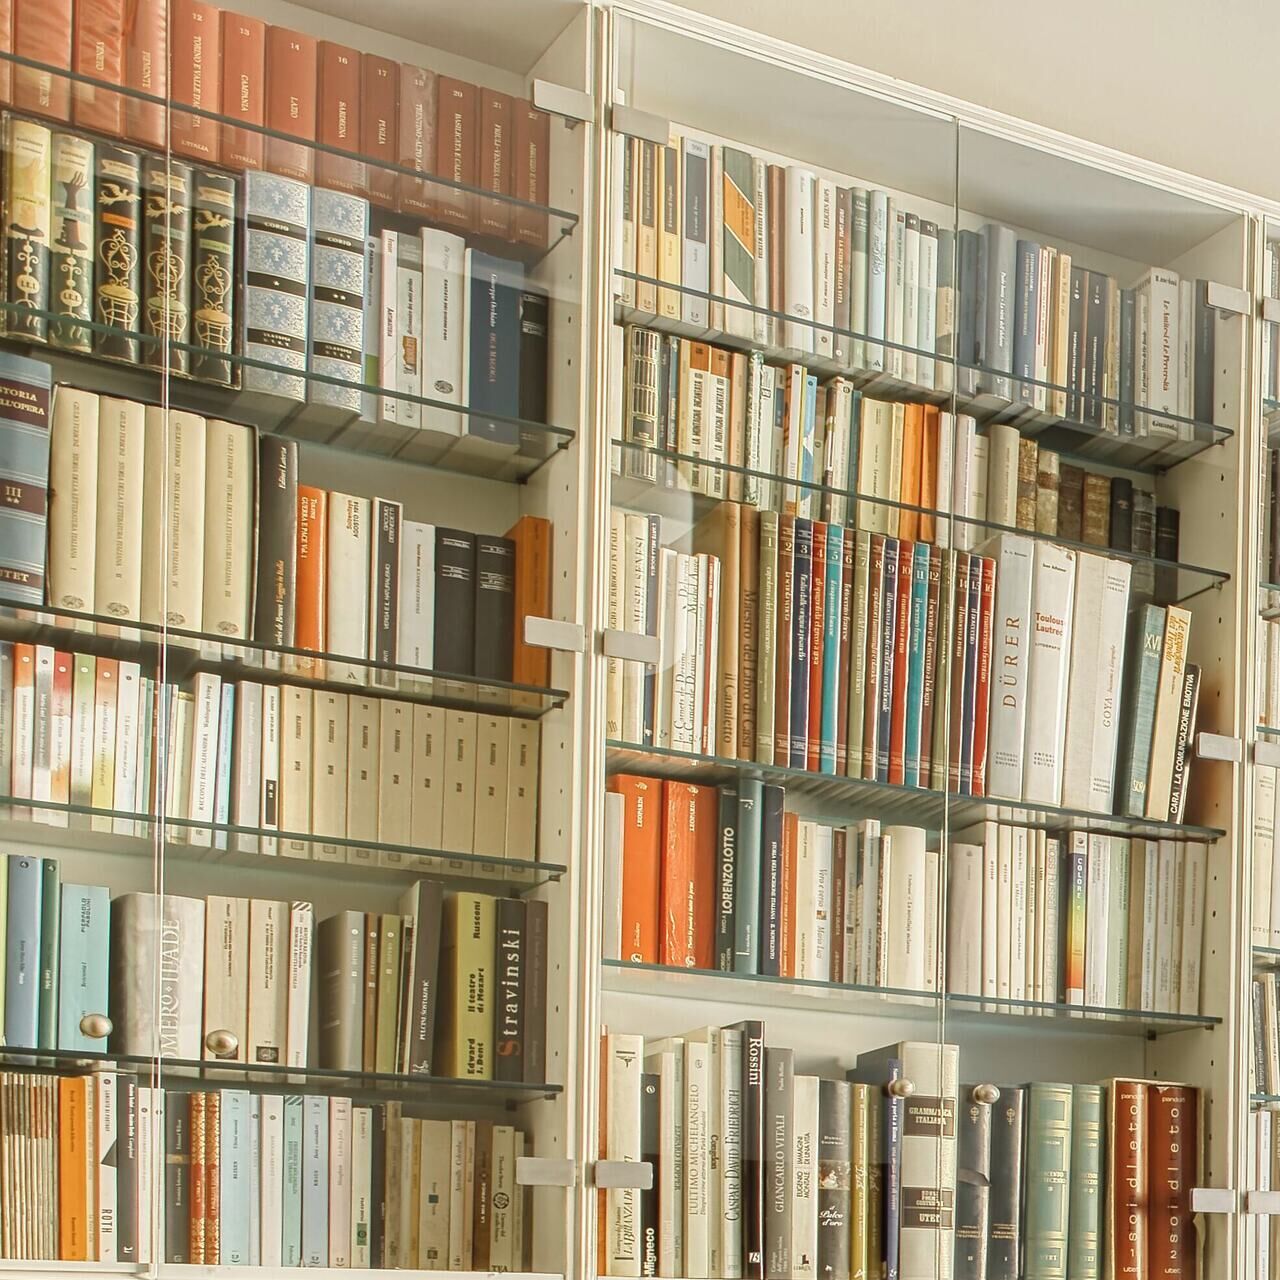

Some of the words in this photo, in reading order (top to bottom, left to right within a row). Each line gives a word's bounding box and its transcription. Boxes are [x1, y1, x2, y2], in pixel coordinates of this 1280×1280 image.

[241, 75, 249, 111] CAMPANIA
[742, 590, 755, 639] Maestro
[743, 644, 755, 662] del
[998, 617, 1020, 708] DÜRER
[742, 666, 754, 699] Libro
[1183, 674, 1195, 707] EMOTIVA
[722, 684, 735, 743] Canaletto
[742, 703, 754, 715] di
[1102, 697, 1113, 728] GOYA
[741, 719, 753, 748] Casa
[1175, 710, 1190, 771] COMUNICAZIONE
[1174, 773, 1182, 784] LA
[723, 827, 735, 864] LOTTO
[722, 864, 734, 915] LORENZO
[473, 901, 481, 939] Rusconi
[467, 1038, 475, 1074] Edward
[749, 1038, 762, 1085] Rossini
[689, 1084, 699, 1165] MICHELANGELO
[775, 1115, 785, 1148] VITALI
[689, 1169, 699, 1215] L'ULTIMO
[775, 1151, 785, 1212] GIANCARLO
[101, 1209, 112, 1233] ROTH
